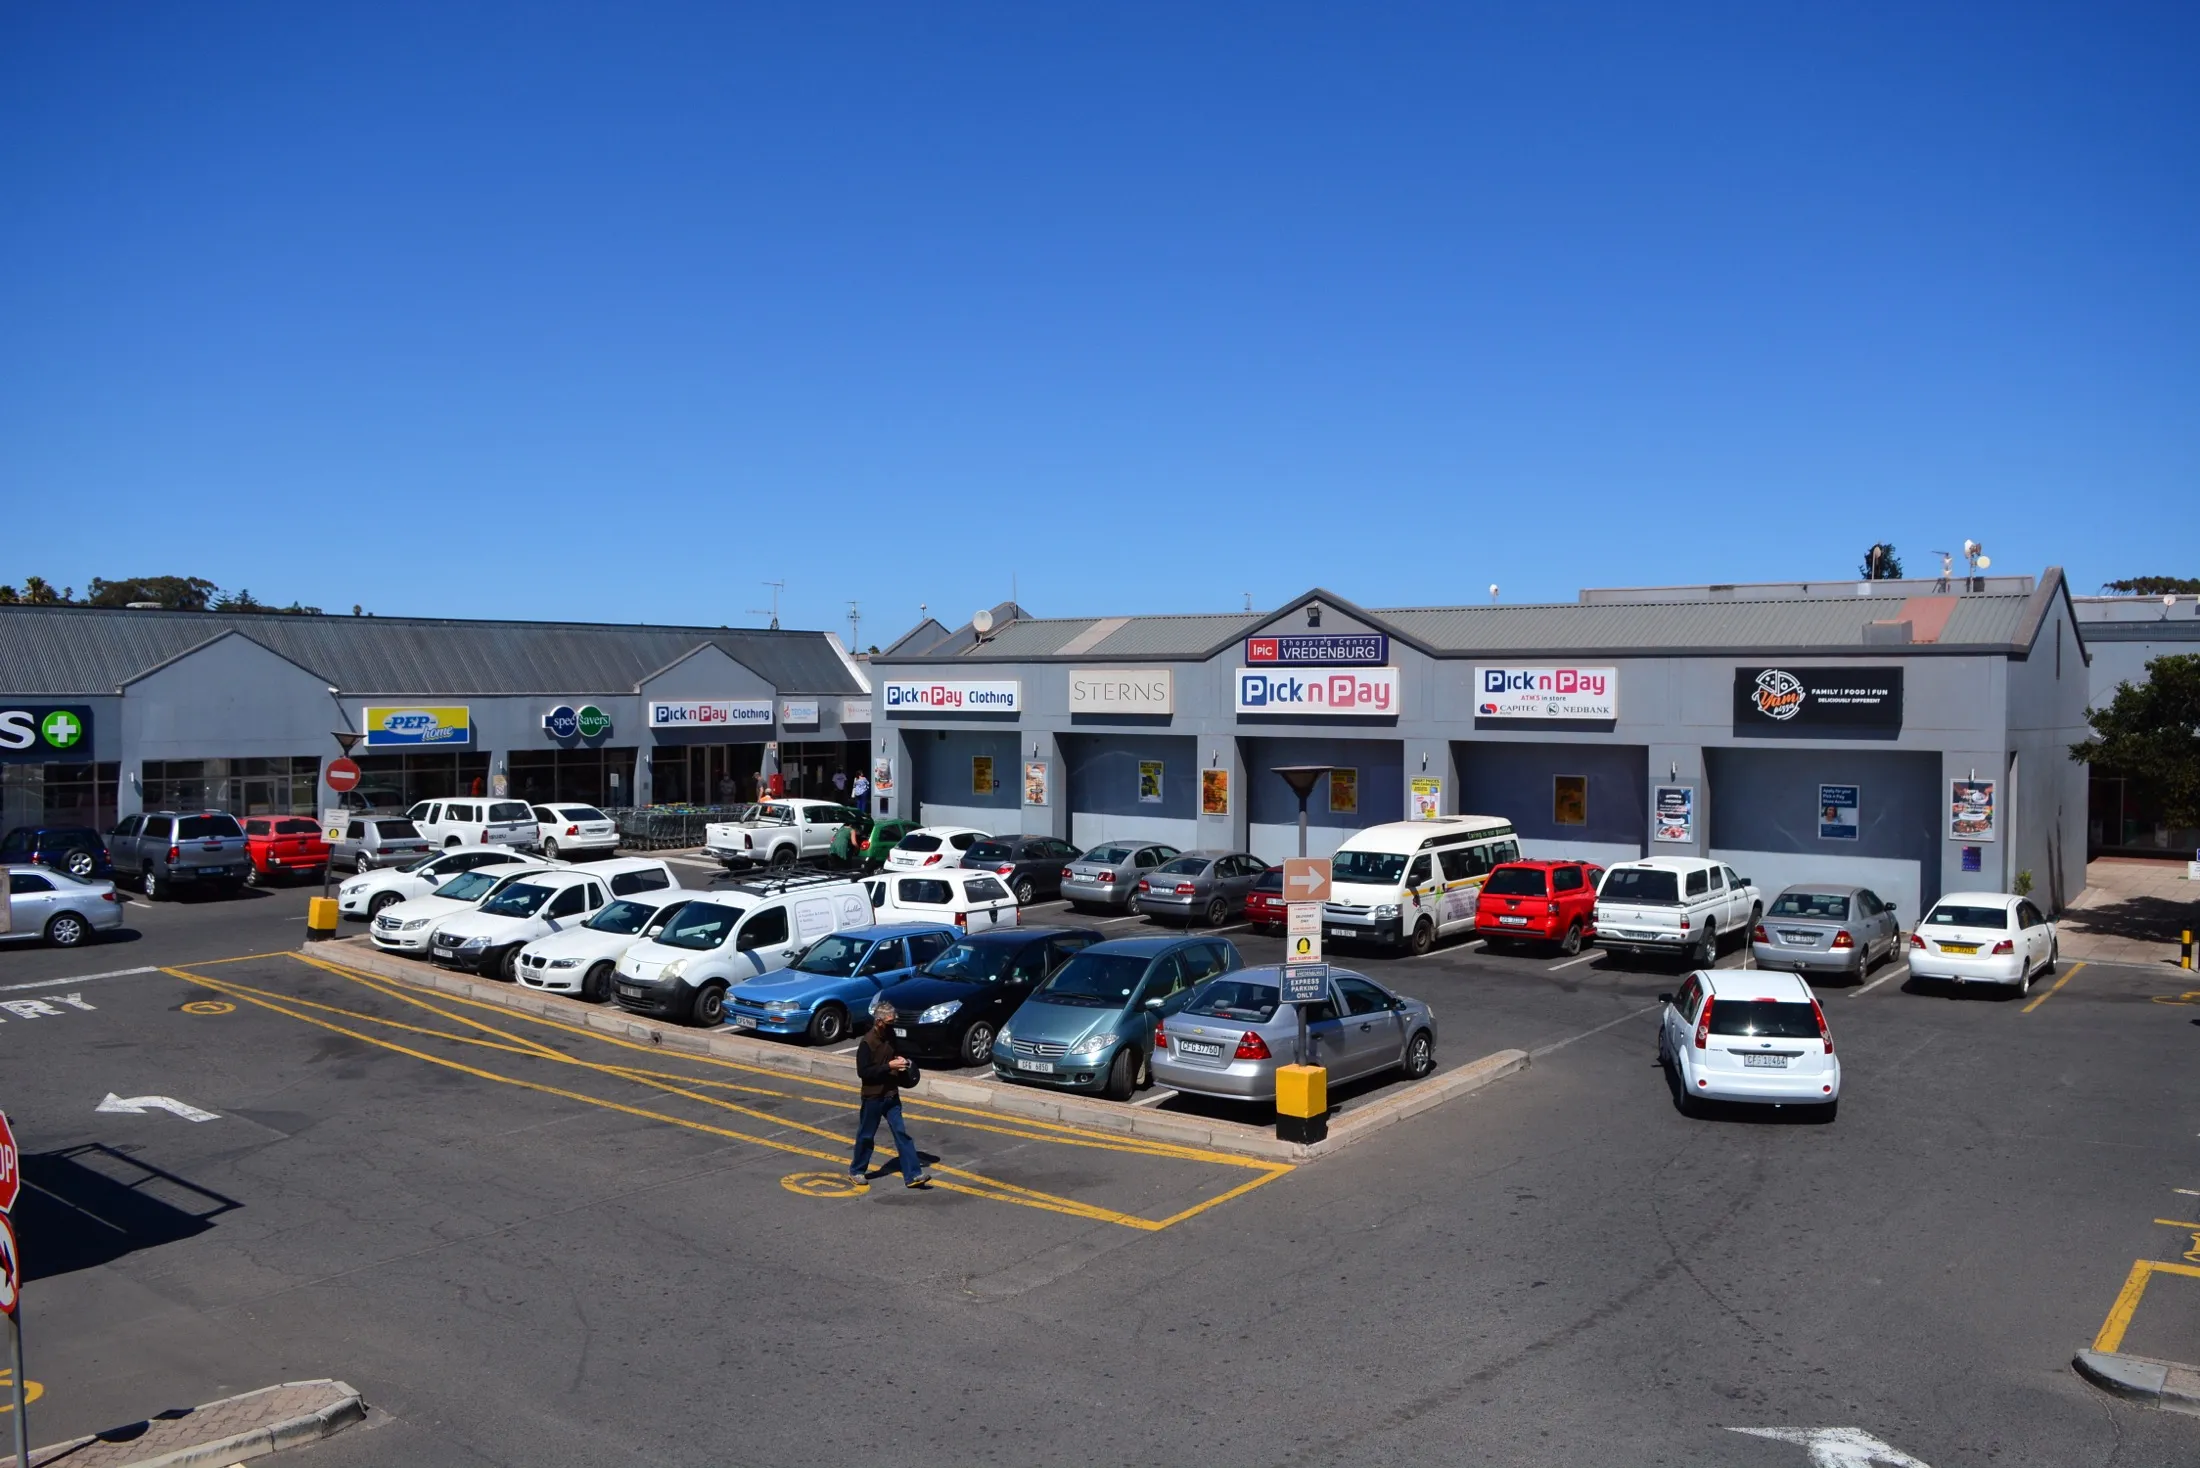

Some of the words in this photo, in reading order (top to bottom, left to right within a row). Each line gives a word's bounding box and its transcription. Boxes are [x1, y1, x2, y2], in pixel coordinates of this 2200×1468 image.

[1282, 639, 1331, 647] Shopping
[1338, 638, 1376, 646] Centre
[1283, 646, 1376, 659] VREDENBURG
[1485, 670, 1535, 693] Pick
[1539, 675, 1552, 690] n
[1556, 670, 1605, 696] Pay
[887, 686, 919, 705] Pick
[920, 690, 929, 703] n
[931, 686, 963, 707] Pay
[969, 690, 1015, 706] Clothing
[1074, 680, 1166, 702] STERNS
[1241, 675, 1304, 706] Pick
[1307, 682, 1324, 703] n
[1328, 675, 1391, 711] Pay
[1811, 688, 1839, 696] FAMILY
[1844, 688, 1866, 696] FOOD
[1871, 688, 1889, 696] FUN
[656, 706, 688, 723] Pick
[689, 710, 697, 721] n
[699, 705, 728, 723] Pay
[732, 709, 770, 721] Clothing
[1500, 704, 1538, 712] CAPITEC
[1563, 706, 1610, 714] NEDBANK
[579, 713, 609, 726] savers
[420, 724, 455, 742] home
[1290, 978, 1320, 986] EXPRESS
